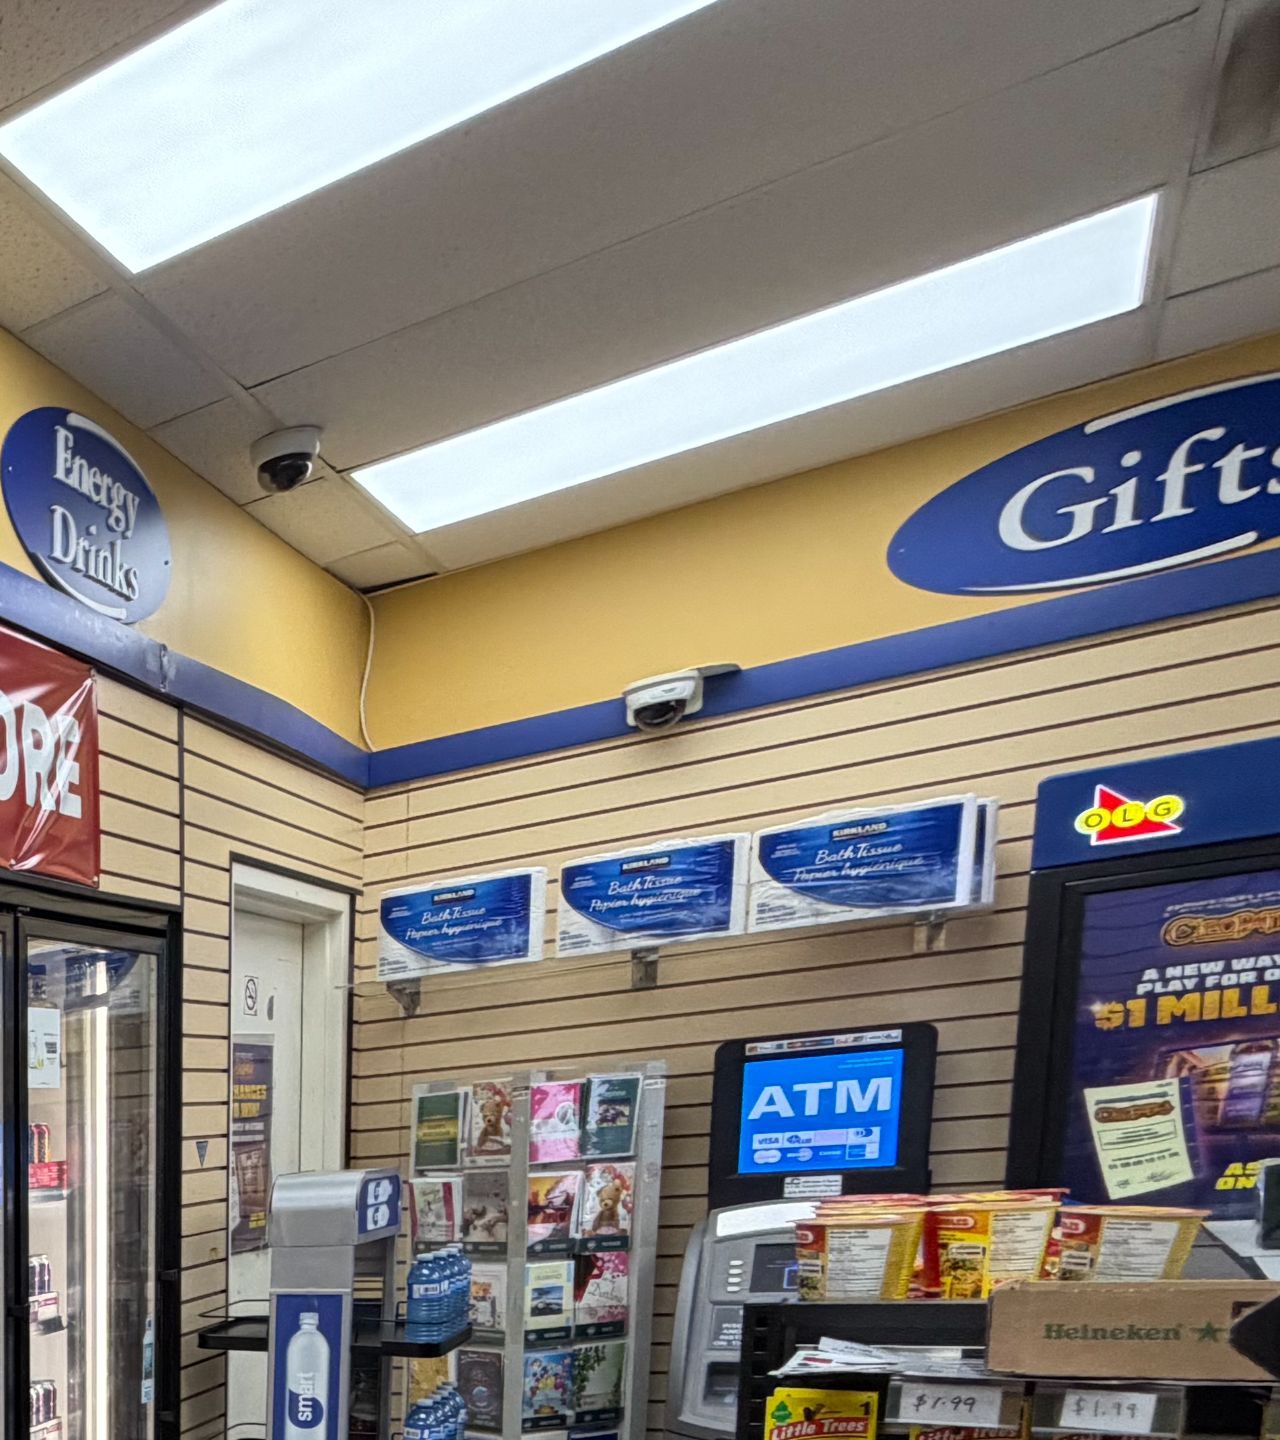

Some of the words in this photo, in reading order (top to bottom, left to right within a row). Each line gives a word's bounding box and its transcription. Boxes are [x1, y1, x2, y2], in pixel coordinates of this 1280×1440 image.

[54, 425, 140, 539] Energy
[51, 505, 140, 600] Drinks
[1083, 796, 1173, 829] OLG
[815, 845, 855, 865] Bath
[608, 881, 641, 895] Bath
[421, 909, 452, 925] Bath
[1136, 977, 1199, 995] PLAY
[1205, 970, 1257, 988] FOR
[1141, 968, 1159, 981] A
[1165, 960, 1225, 979] NEW
[1093, 998, 1147, 1030] $1
[747, 1076, 893, 1120] ATM
[1043, 1322, 1182, 1342] Heineken
[297, 1371, 315, 1423] smart
[822, 1418, 865, 1434] Trees
